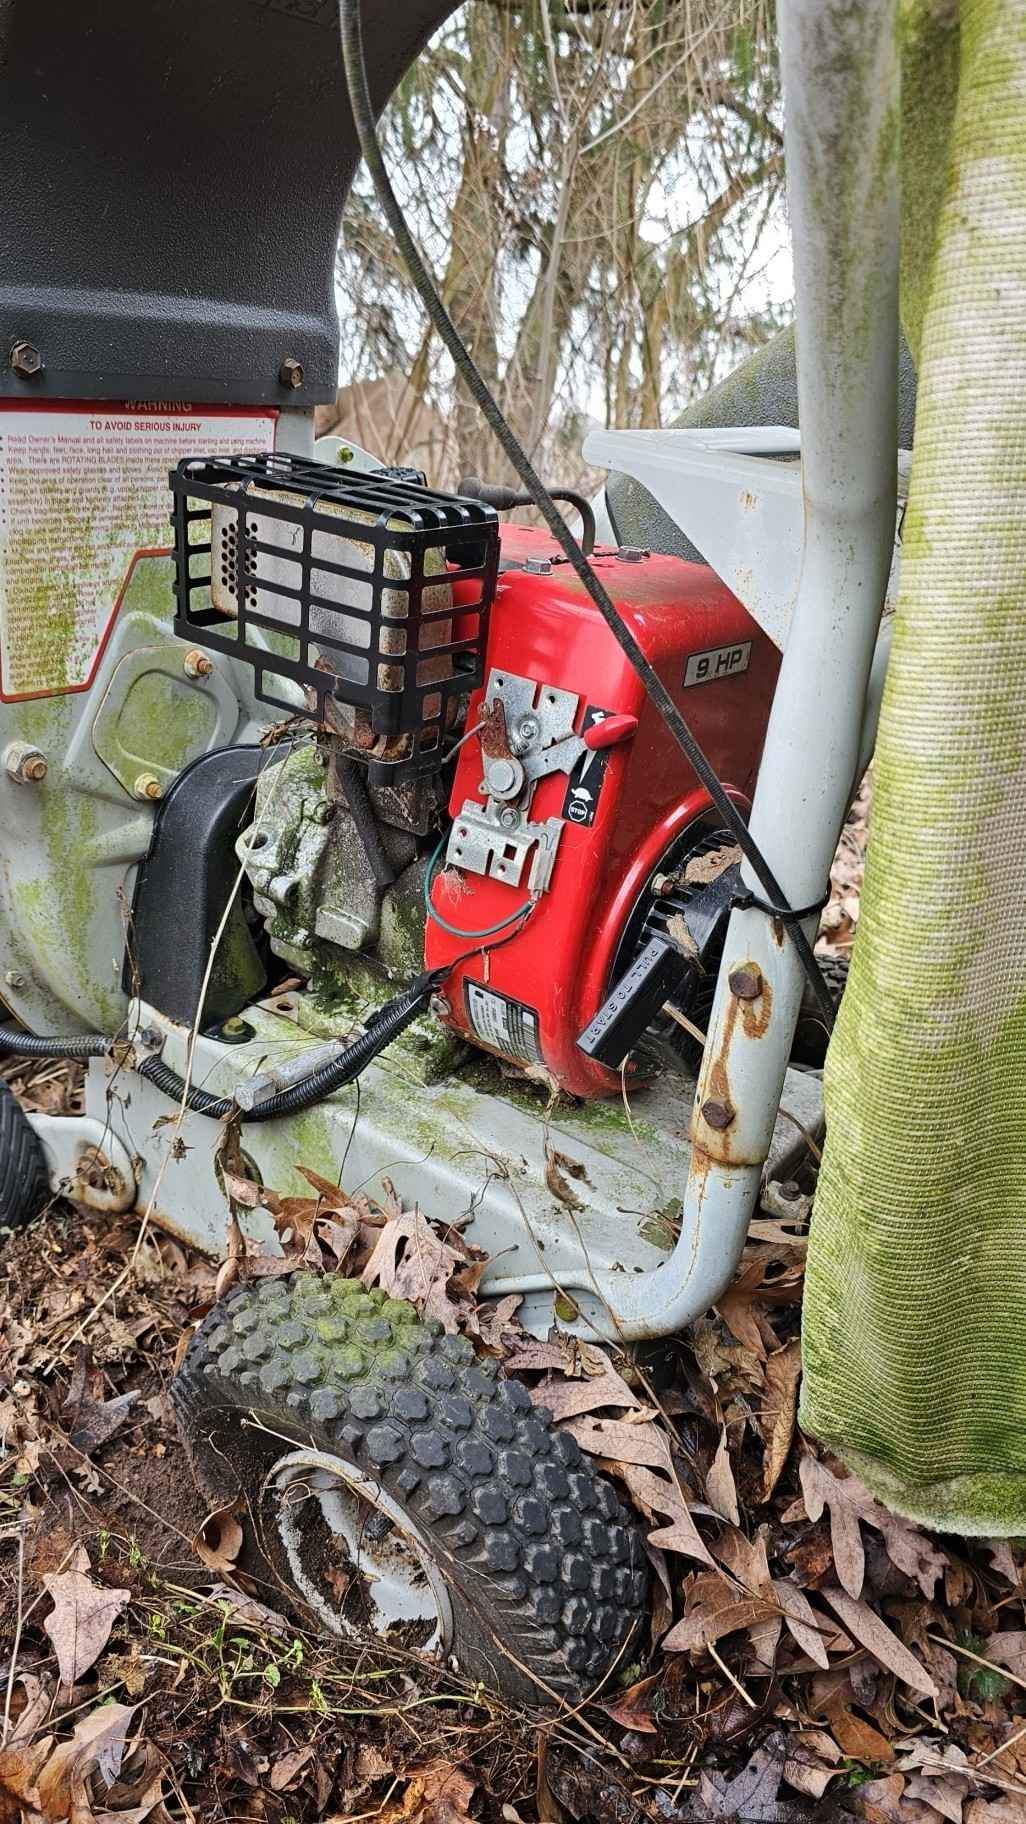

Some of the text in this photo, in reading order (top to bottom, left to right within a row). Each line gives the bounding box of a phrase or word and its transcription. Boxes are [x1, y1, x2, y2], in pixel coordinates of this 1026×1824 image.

[124, 400, 192, 412] WARNING
[90, 421, 202, 432] TO AVOID SERIOUS INJURY
[57, 435, 81, 444] Manual
[83, 436, 95, 444] and
[62, 456, 97, 465] ROTATING
[696, 648, 743, 679] 9 HP
[570, 806, 586, 815] STOP
[587, 950, 658, 1044] PULL TO START
